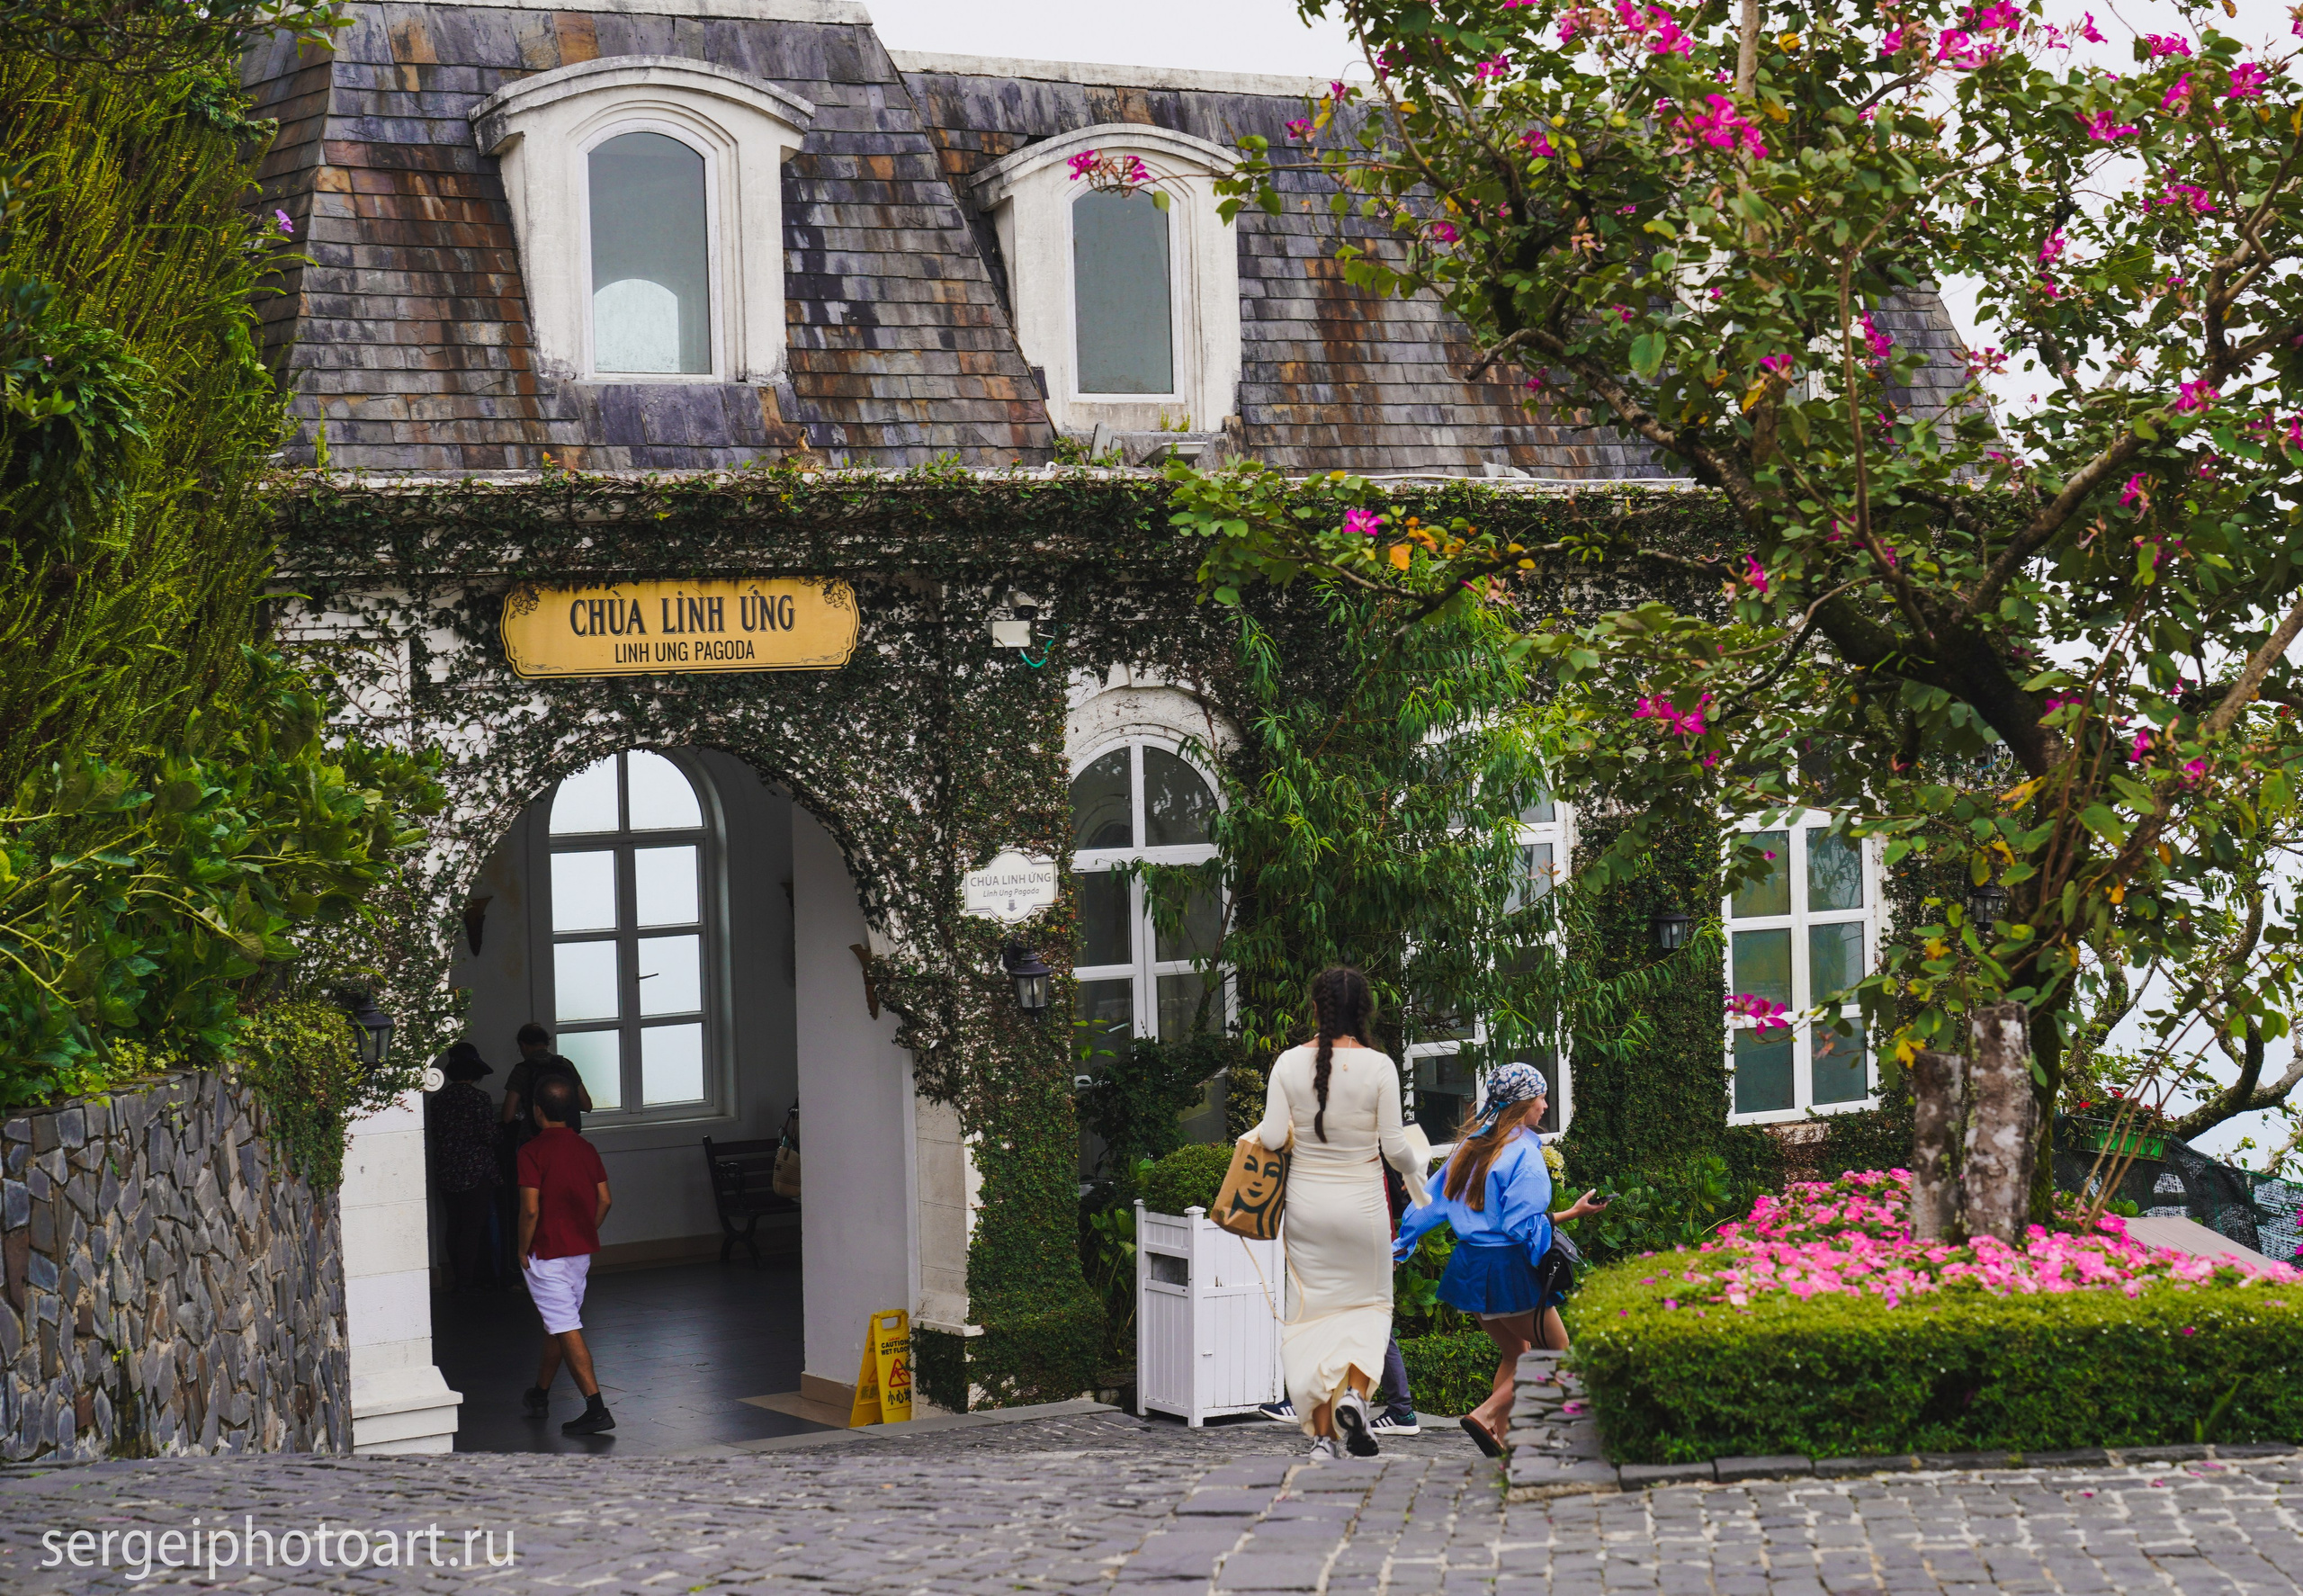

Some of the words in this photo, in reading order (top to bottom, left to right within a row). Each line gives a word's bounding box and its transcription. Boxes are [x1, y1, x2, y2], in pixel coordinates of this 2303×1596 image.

[569, 590, 648, 637] CHÙA
[739, 584, 796, 632] ỨNG
[614, 642, 650, 663] LINH
[655, 641, 689, 662] UNG
[694, 640, 756, 661] PAGODA
[970, 874, 999, 887] CHÙA
[1001, 874, 1026, 885] LINH
[1028, 871, 1052, 883] ỨNG
[982, 890, 998, 898] Linh
[999, 888, 1013, 898] Ung
[1014, 887, 1040, 897] Pagoda
